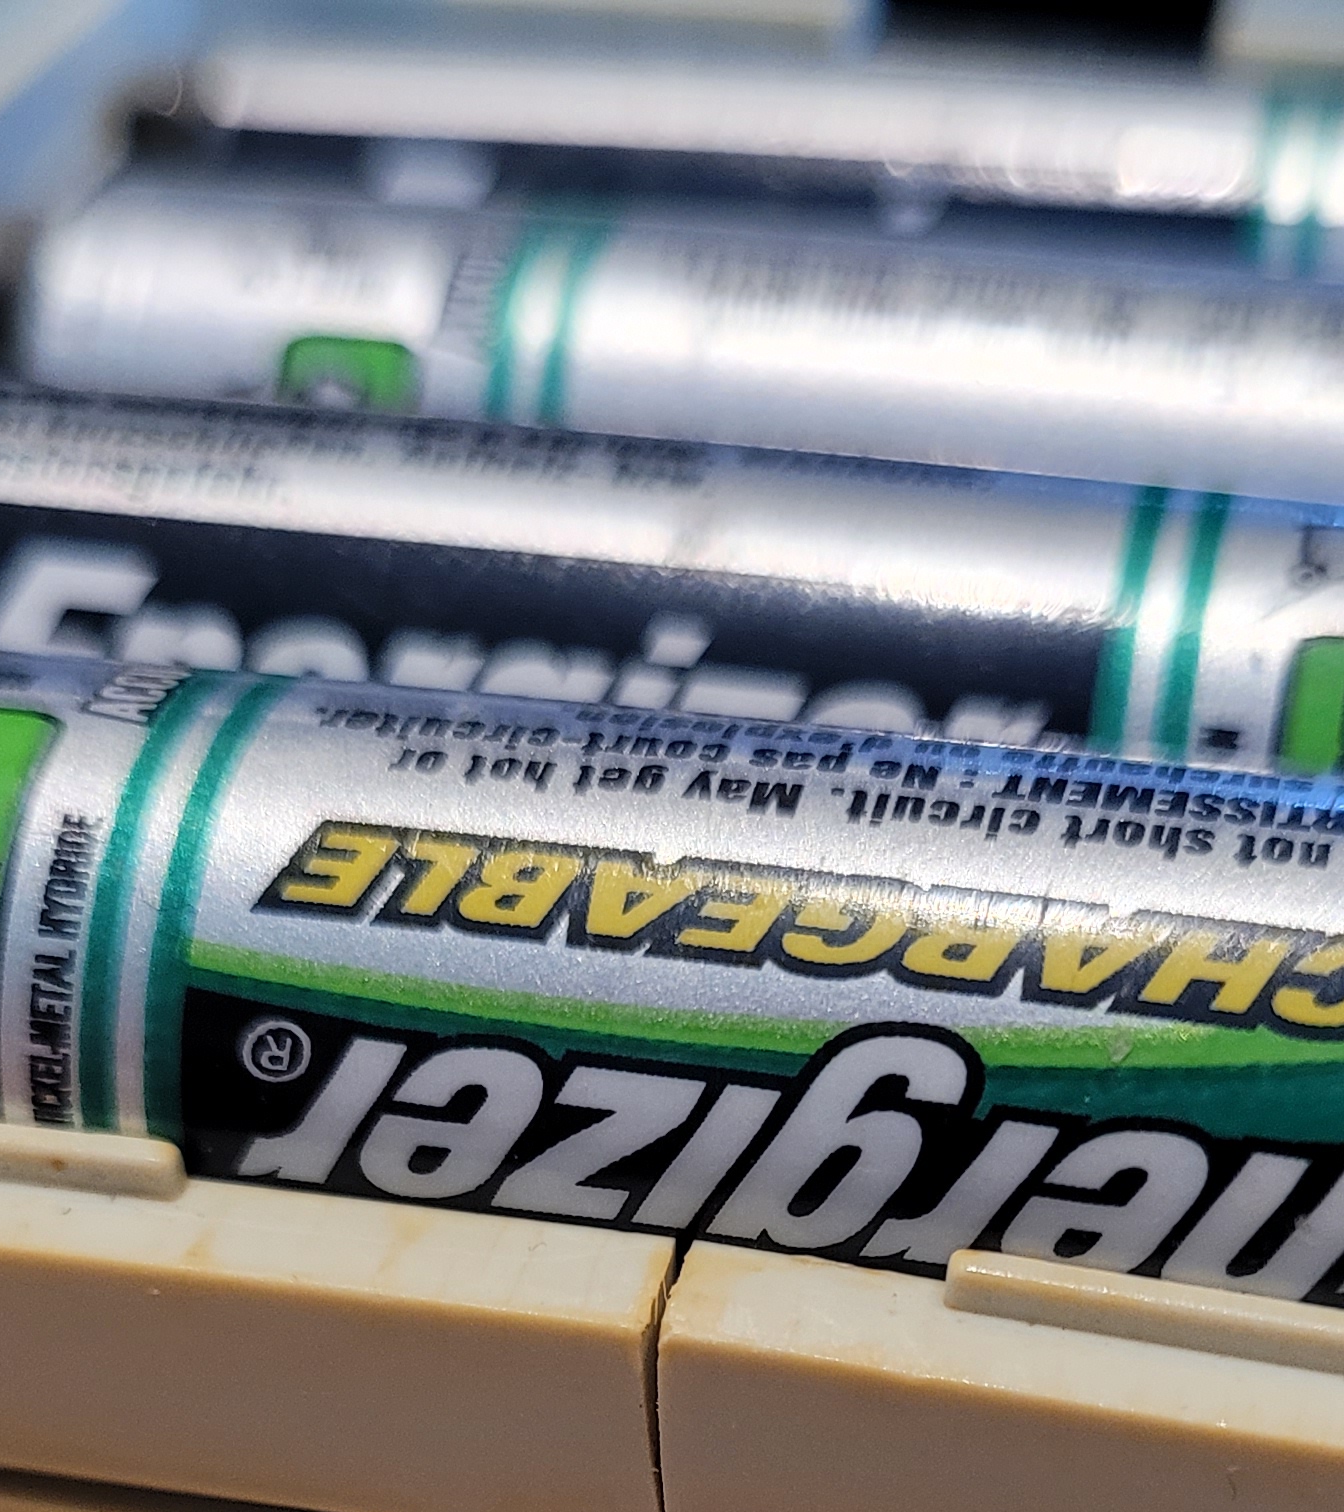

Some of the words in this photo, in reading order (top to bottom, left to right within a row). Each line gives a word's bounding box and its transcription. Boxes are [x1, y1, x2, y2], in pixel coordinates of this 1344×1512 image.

[316, 704, 730, 765] court-circuiter.
[389, 746, 448, 775] or
[464, 753, 559, 795] hot
[750, 741, 856, 775] pas
[868, 760, 942, 791] Ne
[571, 763, 670, 797] get
[680, 769, 806, 818] May
[831, 786, 1042, 842] circuit.
[1060, 813, 1216, 861] short
[1238, 833, 1333, 870] not
[38, 812, 102, 943] HYDRIDE
